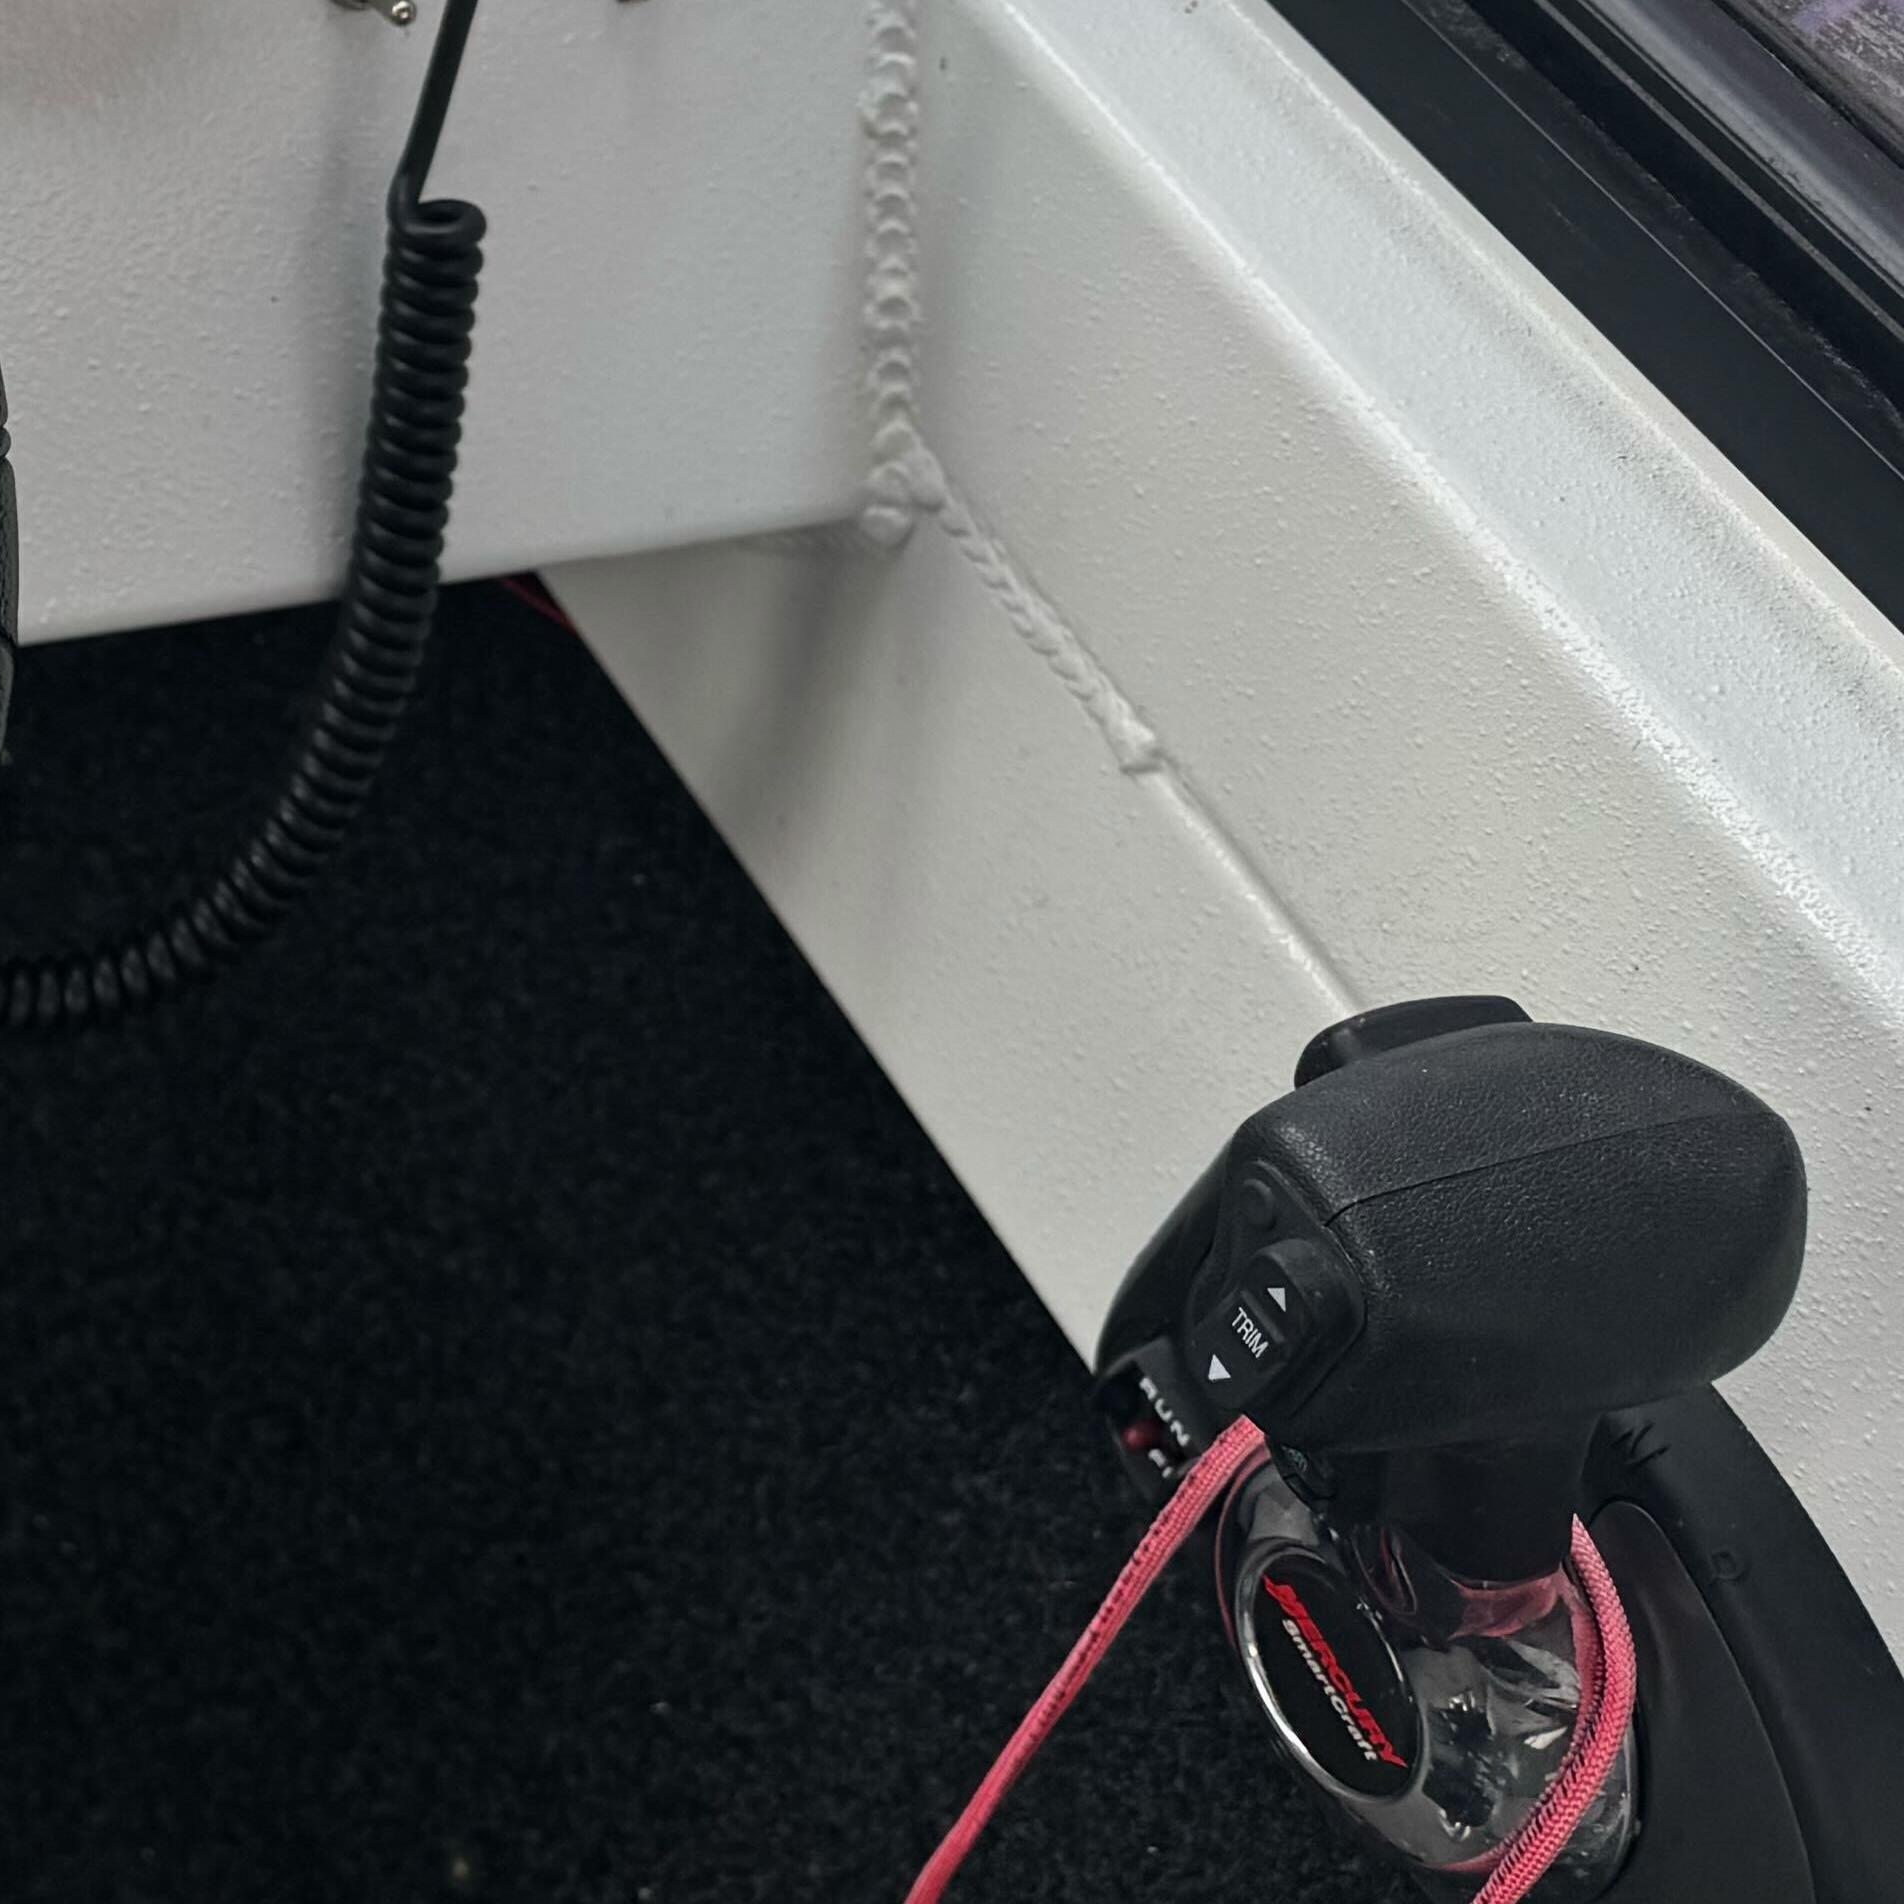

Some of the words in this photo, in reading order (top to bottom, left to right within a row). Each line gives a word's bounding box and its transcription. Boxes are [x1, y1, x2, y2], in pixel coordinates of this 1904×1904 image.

[1231, 1306, 1269, 1359] TRIM
[1139, 1377, 1191, 1447] RUN
[1281, 1618, 1378, 1761] SmartCraft
